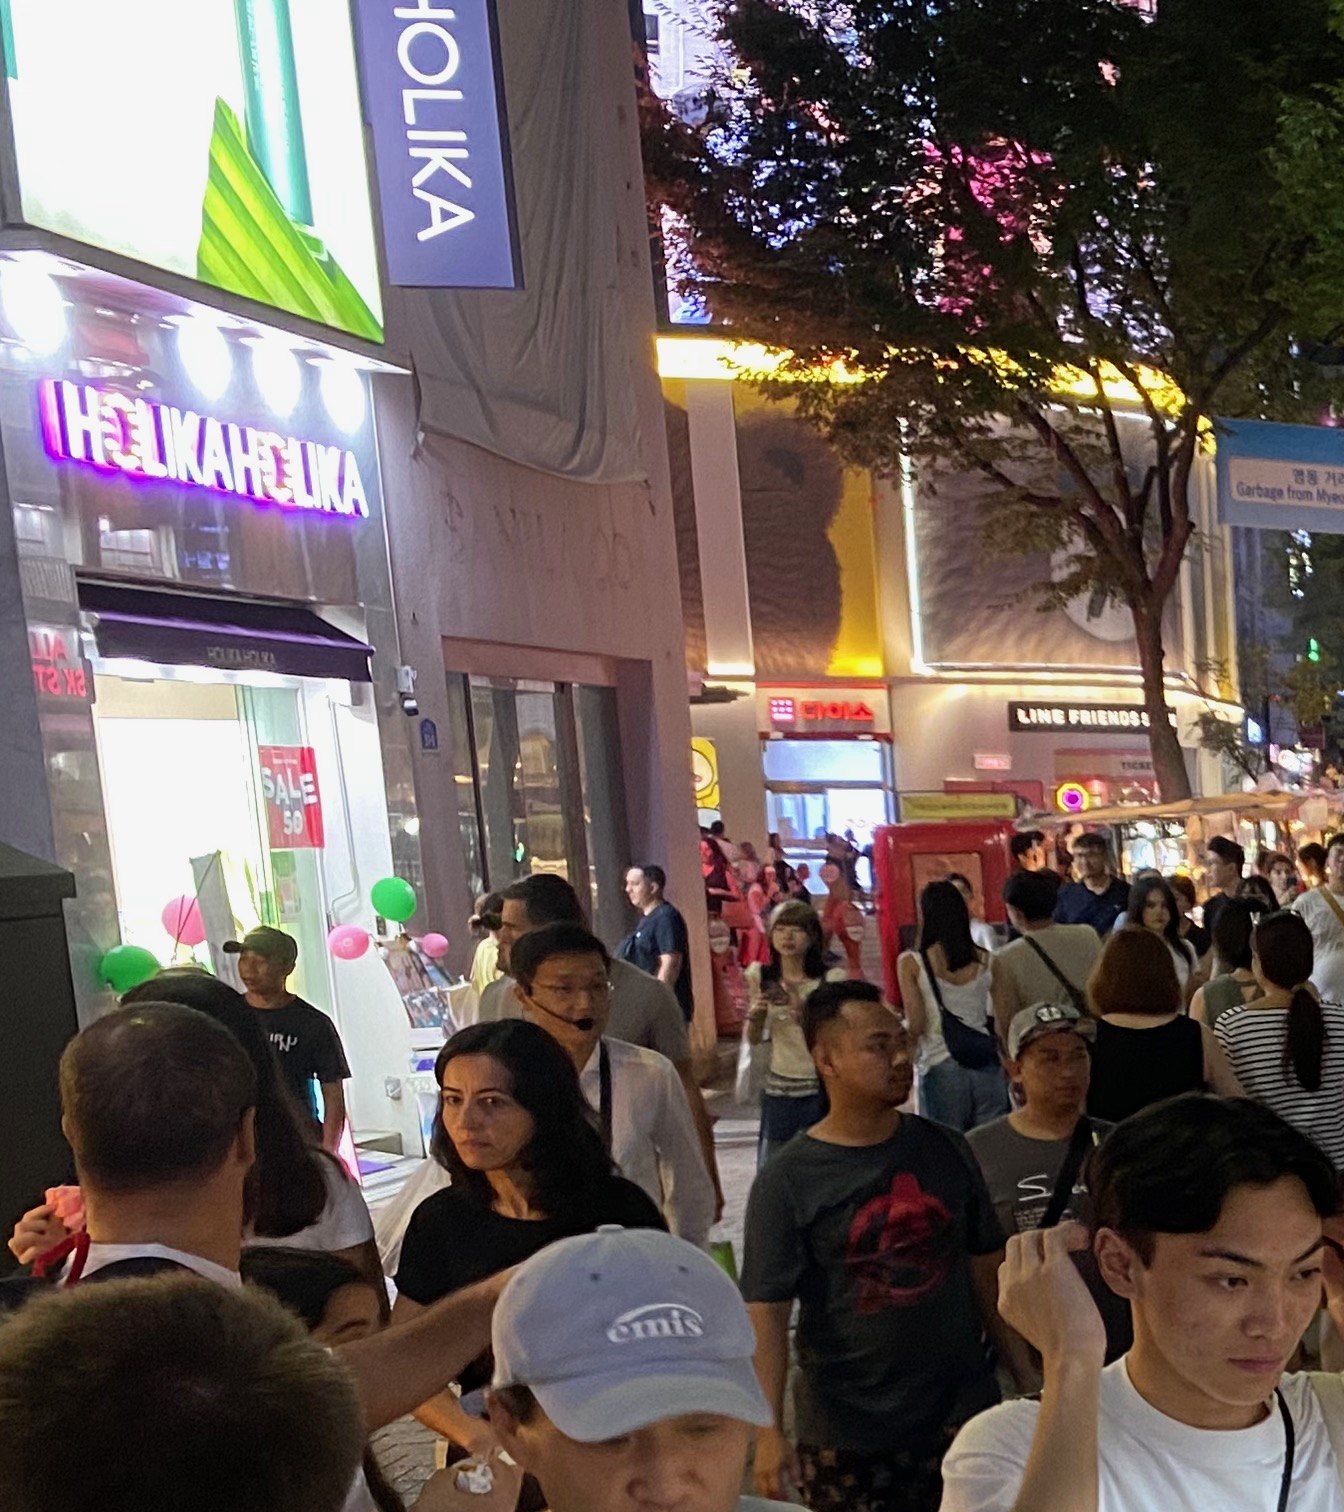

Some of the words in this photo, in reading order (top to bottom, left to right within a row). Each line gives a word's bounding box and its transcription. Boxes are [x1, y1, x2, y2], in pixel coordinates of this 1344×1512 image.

[1236, 480, 1284, 501] Garbage
[1287, 484, 1313, 500] from
[801, 702, 875, 721] 다이소
[1017, 708, 1065, 726] LINE
[1069, 709, 1142, 727] FRIENDS
[1121, 761, 1153, 771] TICKE
[262, 766, 318, 806] SALE
[607, 1310, 705, 1345] emis
